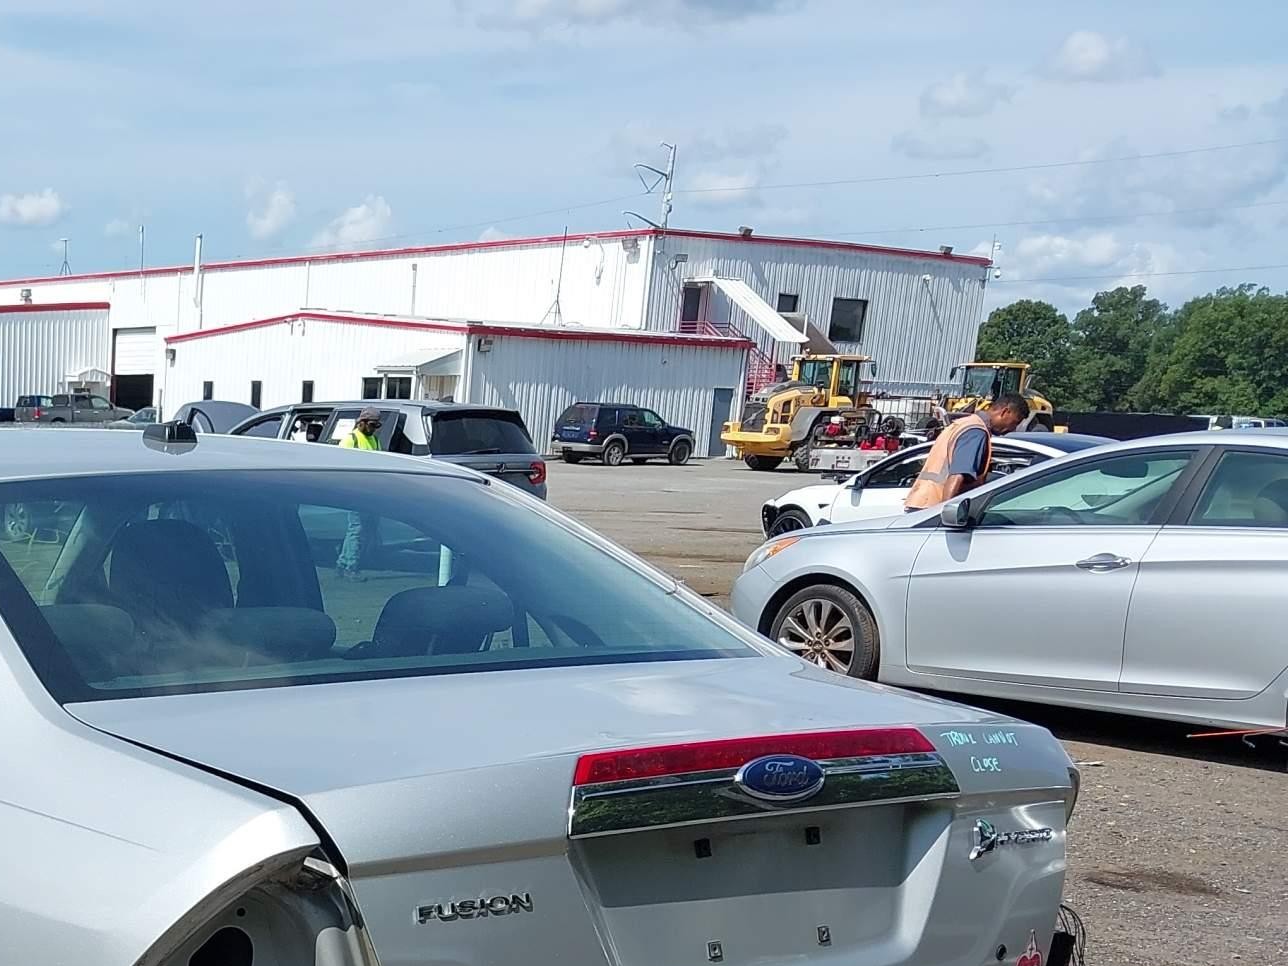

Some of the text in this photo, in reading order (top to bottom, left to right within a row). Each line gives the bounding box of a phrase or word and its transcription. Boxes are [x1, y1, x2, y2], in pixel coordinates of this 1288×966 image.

[764, 760, 809, 787] Ford
[970, 756, 1002, 772] CLOSE
[413, 892, 534, 925] FUSION
